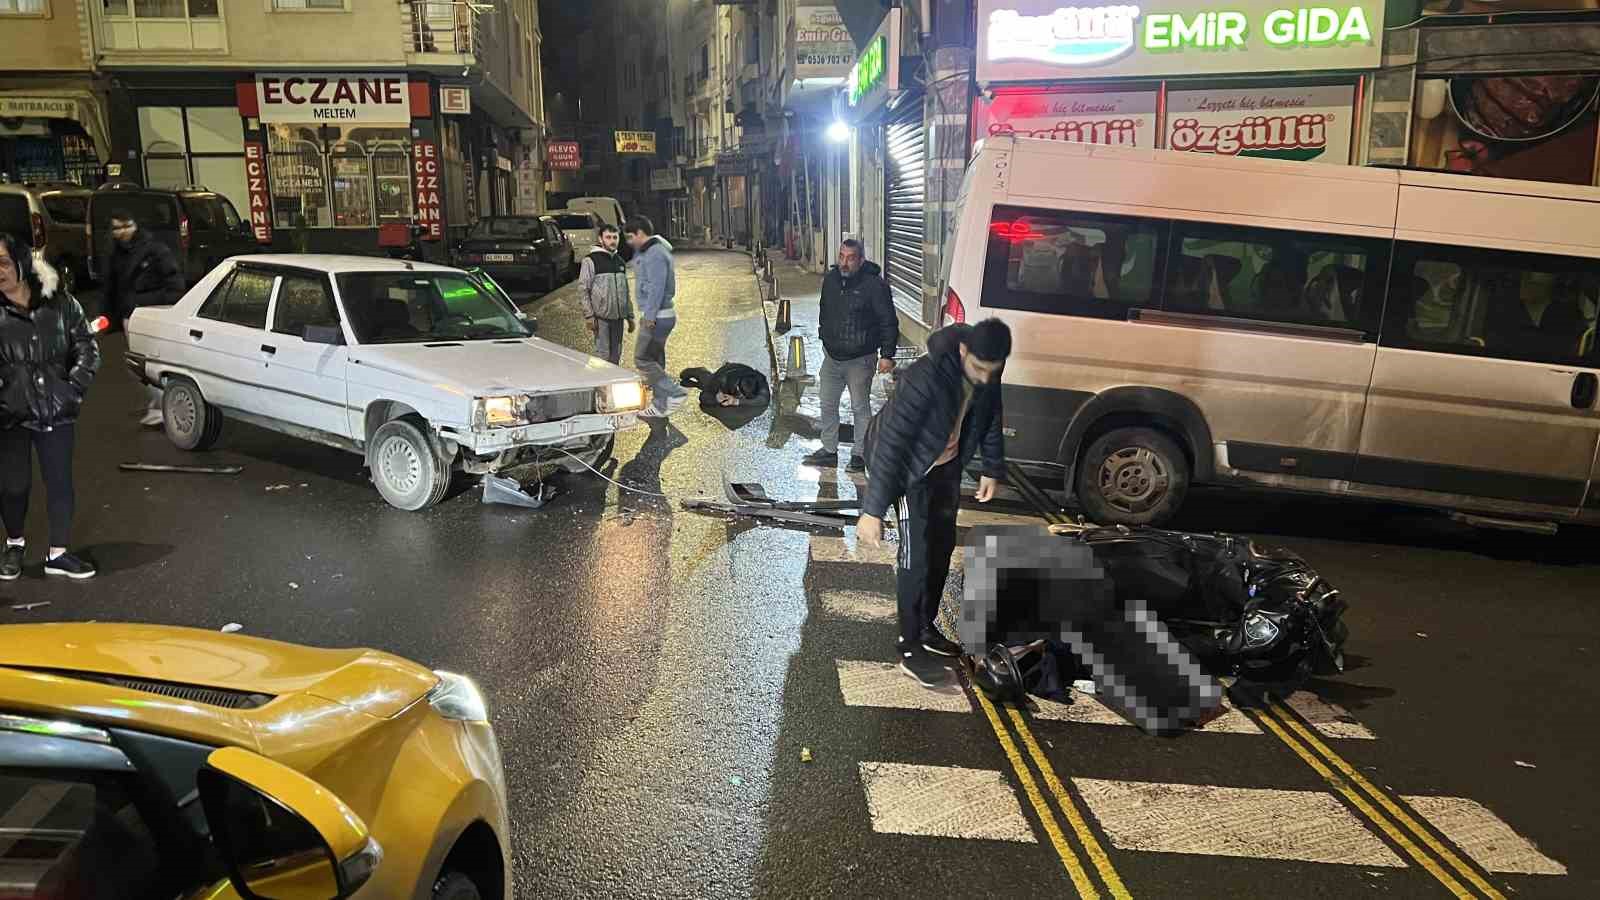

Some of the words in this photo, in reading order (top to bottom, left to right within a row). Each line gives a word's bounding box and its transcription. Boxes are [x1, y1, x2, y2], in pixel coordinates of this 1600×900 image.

[1262, 6, 1371, 45] GIDA
[262, 77, 403, 105] ECZANE
[313, 108, 356, 119] MELTEM
[1171, 113, 1327, 156] özgüllü
[246, 146, 267, 239] ECZANE
[424, 145, 441, 236] ECZANE
